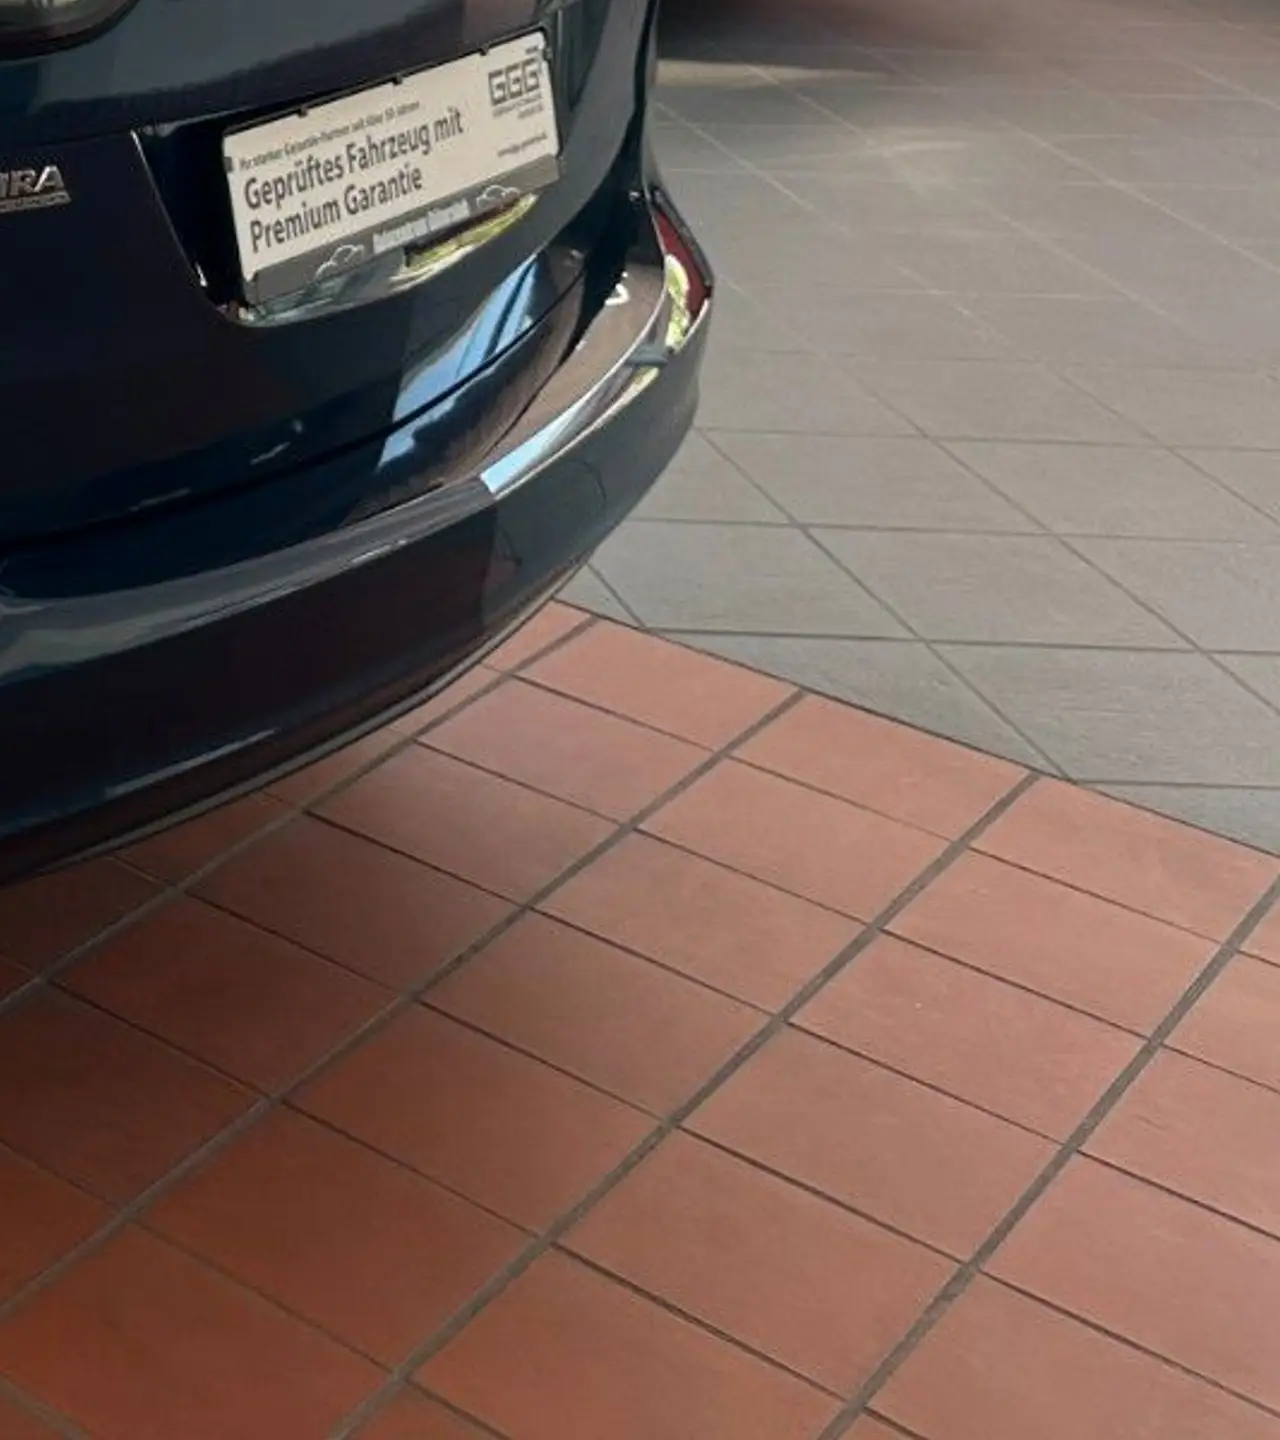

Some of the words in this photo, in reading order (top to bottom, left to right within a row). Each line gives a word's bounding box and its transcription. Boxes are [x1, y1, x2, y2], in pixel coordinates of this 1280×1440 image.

[488, 57, 541, 107] GGG
[245, 154, 345, 211] Geprüftes
[346, 130, 431, 174] Fahrzeug
[434, 109, 463, 144] mit
[250, 195, 342, 252] Premium
[343, 164, 423, 215] Garantie
